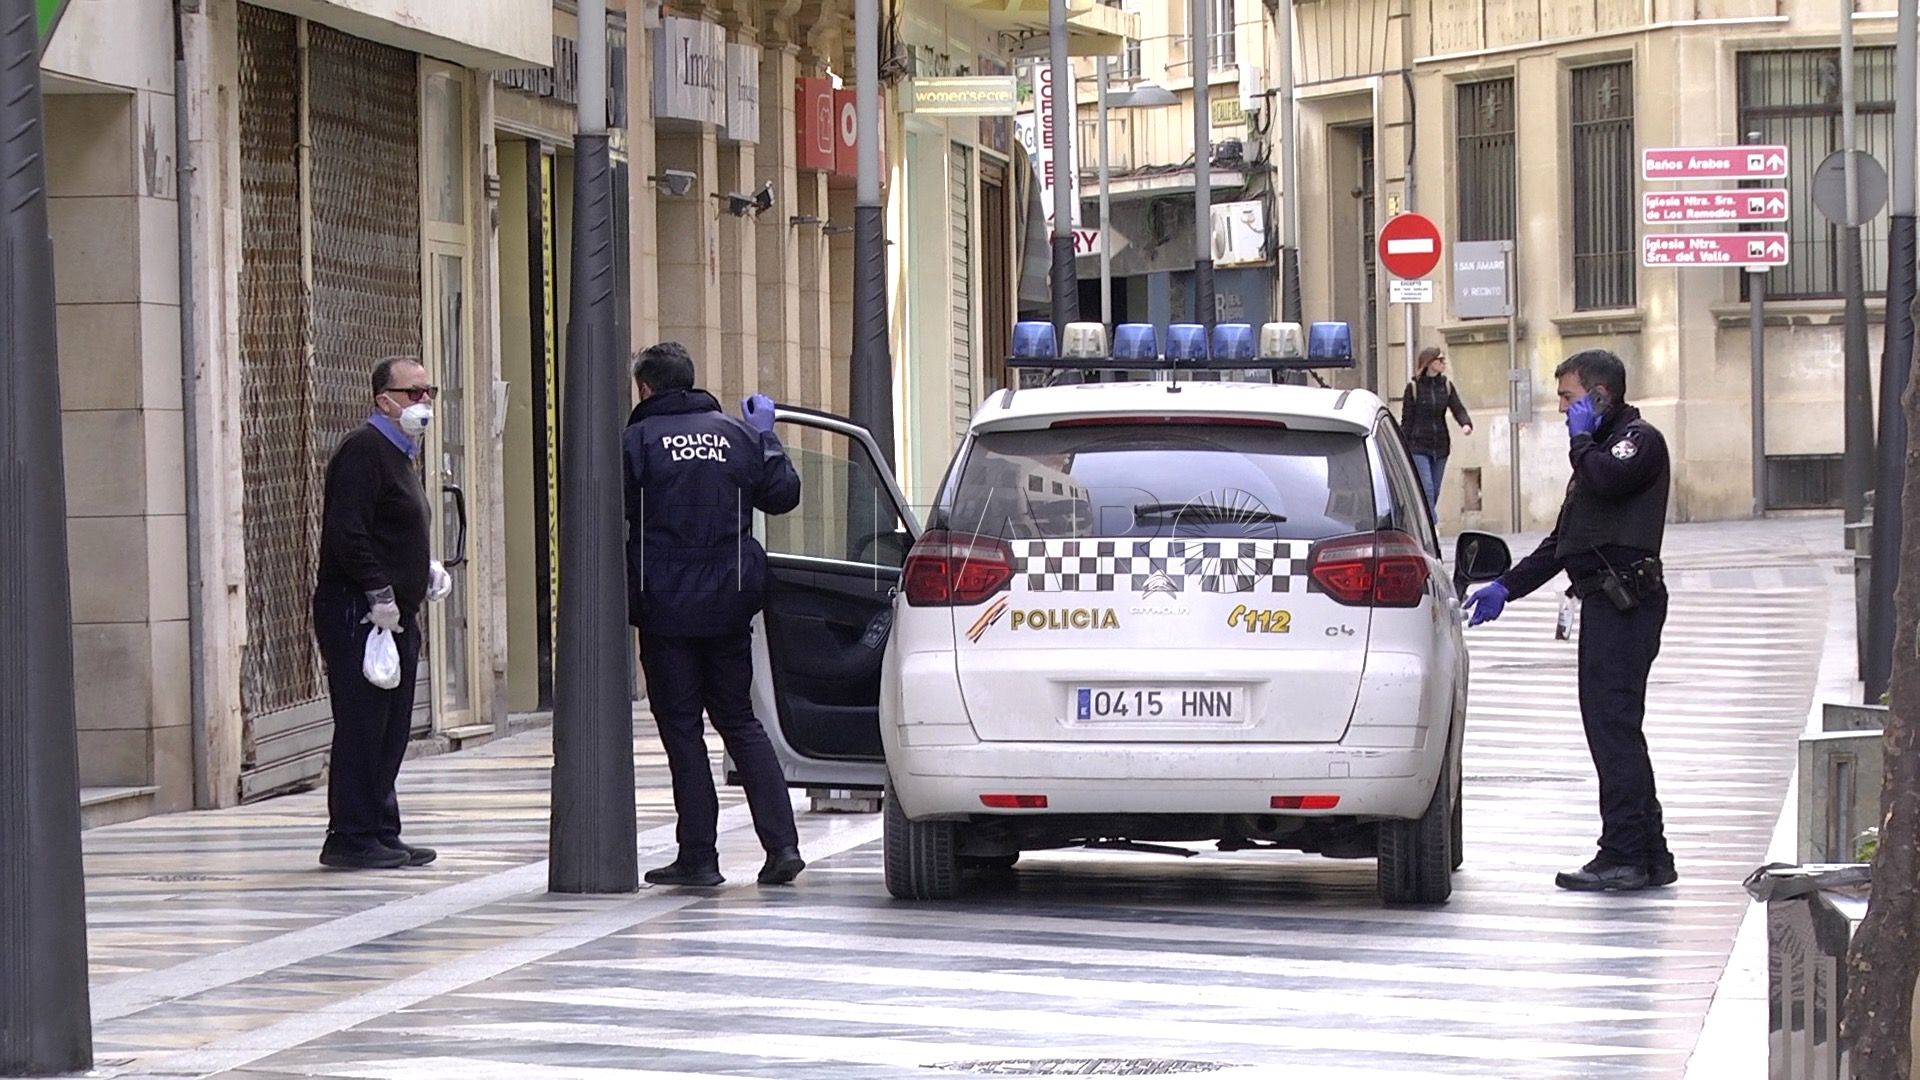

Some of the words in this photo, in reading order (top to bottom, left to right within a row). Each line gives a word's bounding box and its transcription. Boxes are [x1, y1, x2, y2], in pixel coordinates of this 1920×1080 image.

[1646, 158, 1683, 170] Baños
[1688, 156, 1731, 170] Árabes
[1646, 209, 1660, 219] de
[1664, 209, 1683, 219] Los
[1686, 207, 1738, 219] Remedios
[1675, 251, 1695, 262] del
[1699, 251, 1731, 262] Valle
[662, 433, 731, 449] POLICIA
[671, 446, 727, 462] LOCAL
[1011, 608, 1121, 631] POLICIA
[1243, 609, 1292, 634] 112
[1324, 624, 1356, 637] C4
[1094, 690, 1164, 717] 0415
[1181, 690, 1232, 717] HNN
